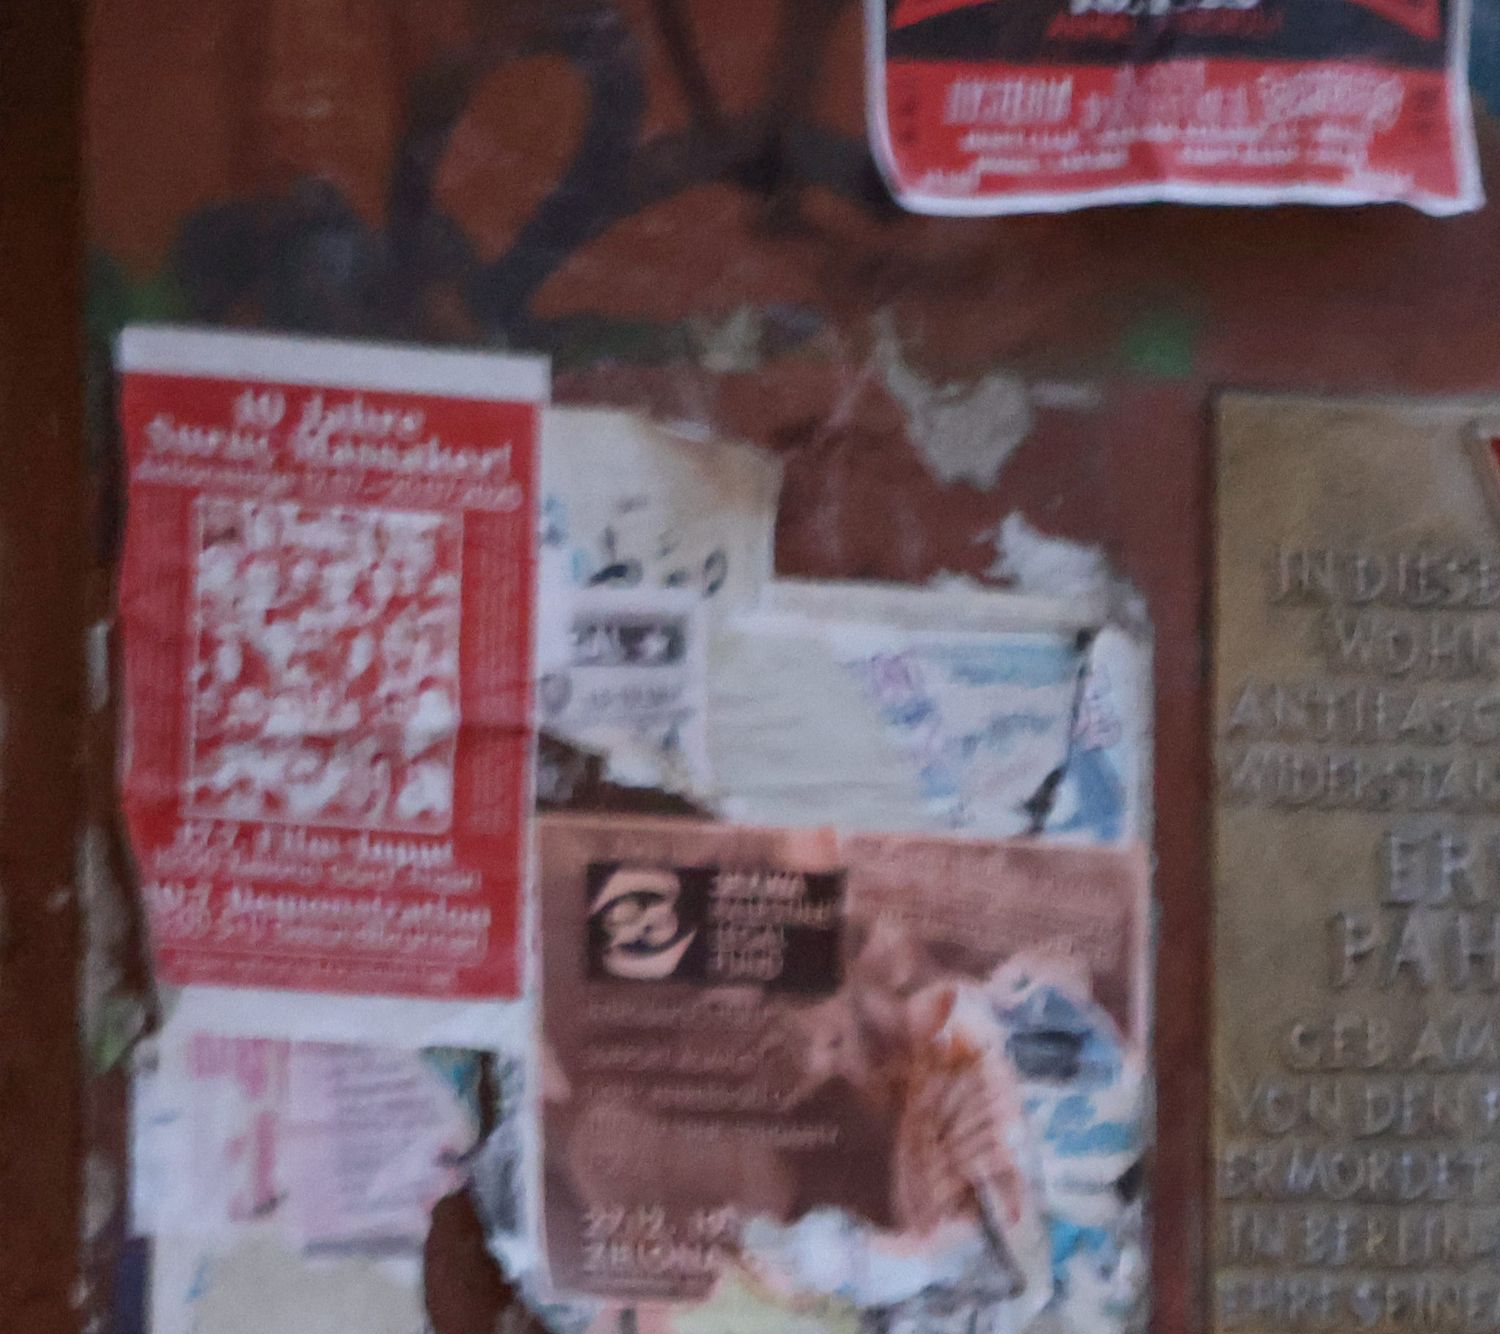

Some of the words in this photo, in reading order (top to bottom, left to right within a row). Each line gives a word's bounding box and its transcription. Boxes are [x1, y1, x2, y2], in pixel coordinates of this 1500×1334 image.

[1409, 1018, 1498, 1071] AM
[1363, 1084, 1468, 1138] DEN
[1222, 1143, 1486, 1202] ERMORDET
